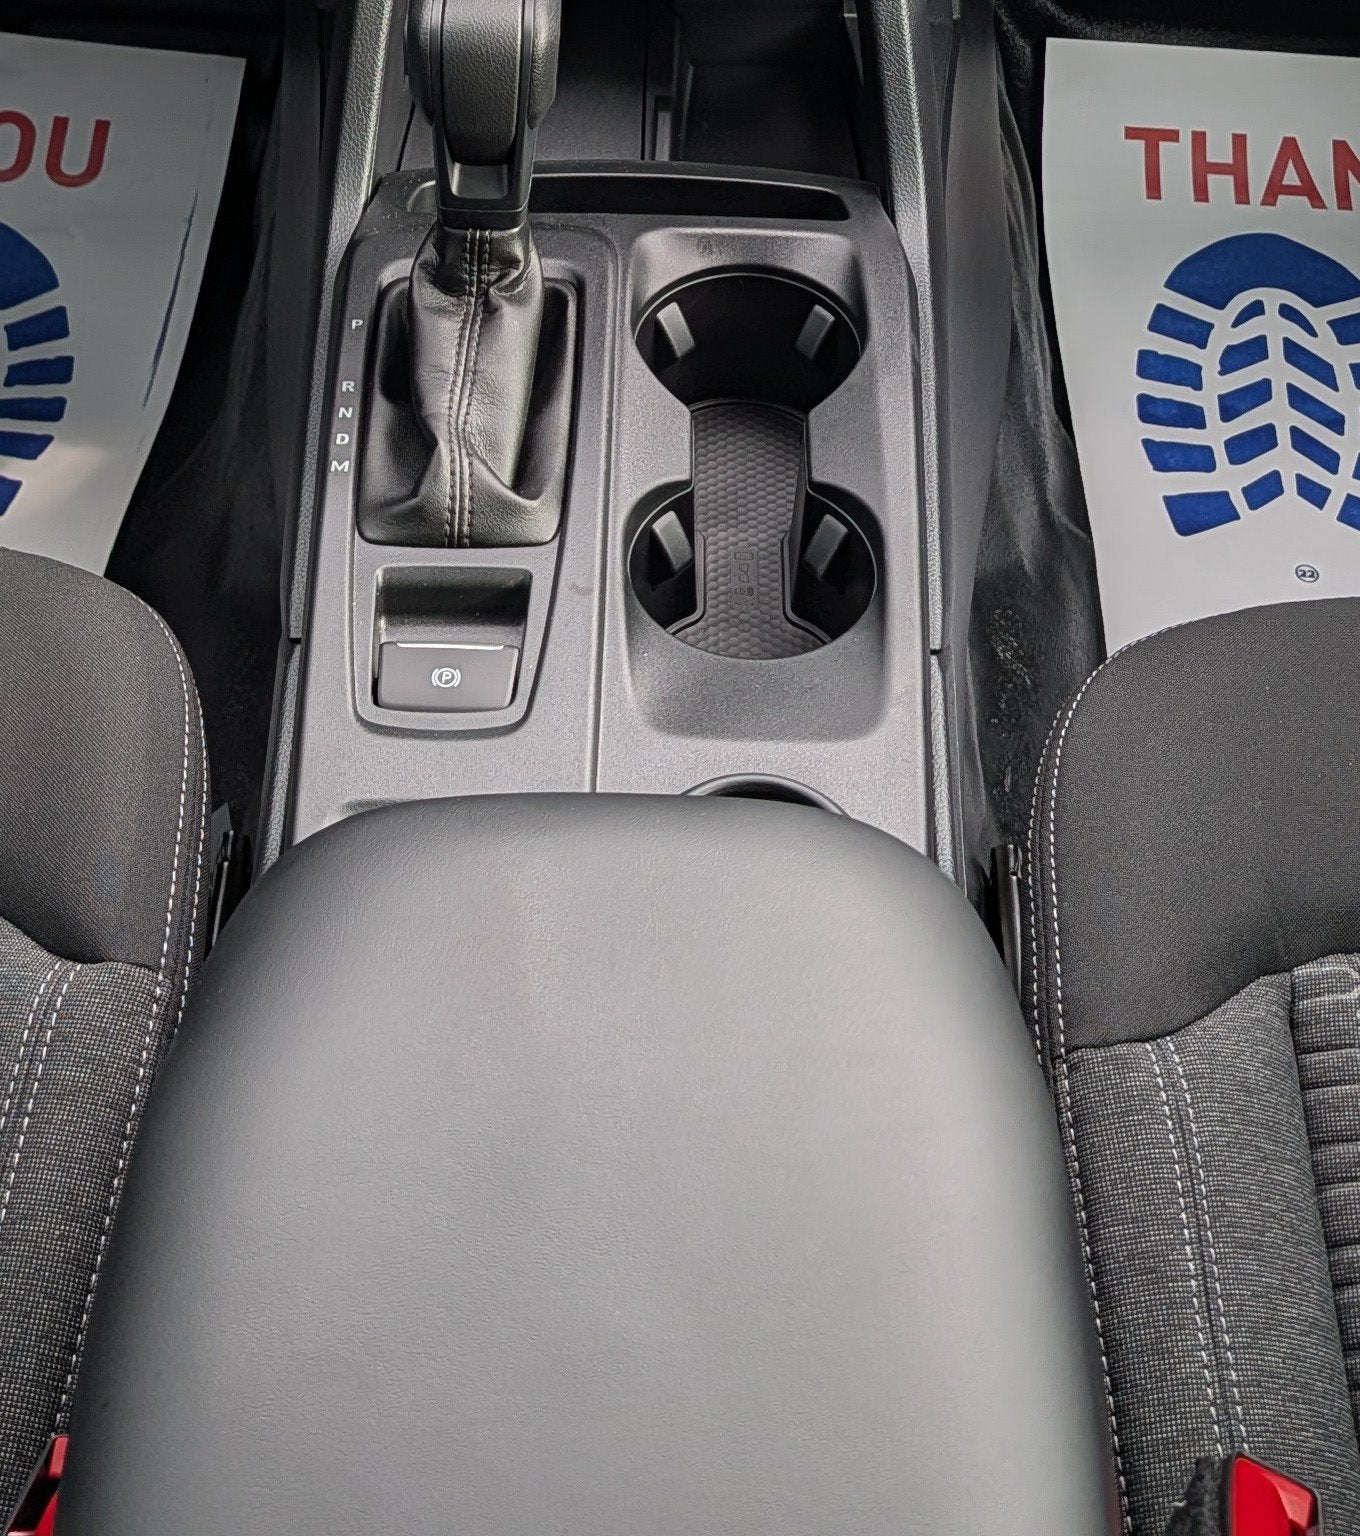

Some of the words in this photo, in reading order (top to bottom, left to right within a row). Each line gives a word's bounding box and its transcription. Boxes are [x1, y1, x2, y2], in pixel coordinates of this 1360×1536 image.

[351, 319, 363, 330] P
[341, 380, 355, 393] R
[338, 406, 353, 419] N
[335, 433, 350, 445] D
[330, 460, 350, 472] M
